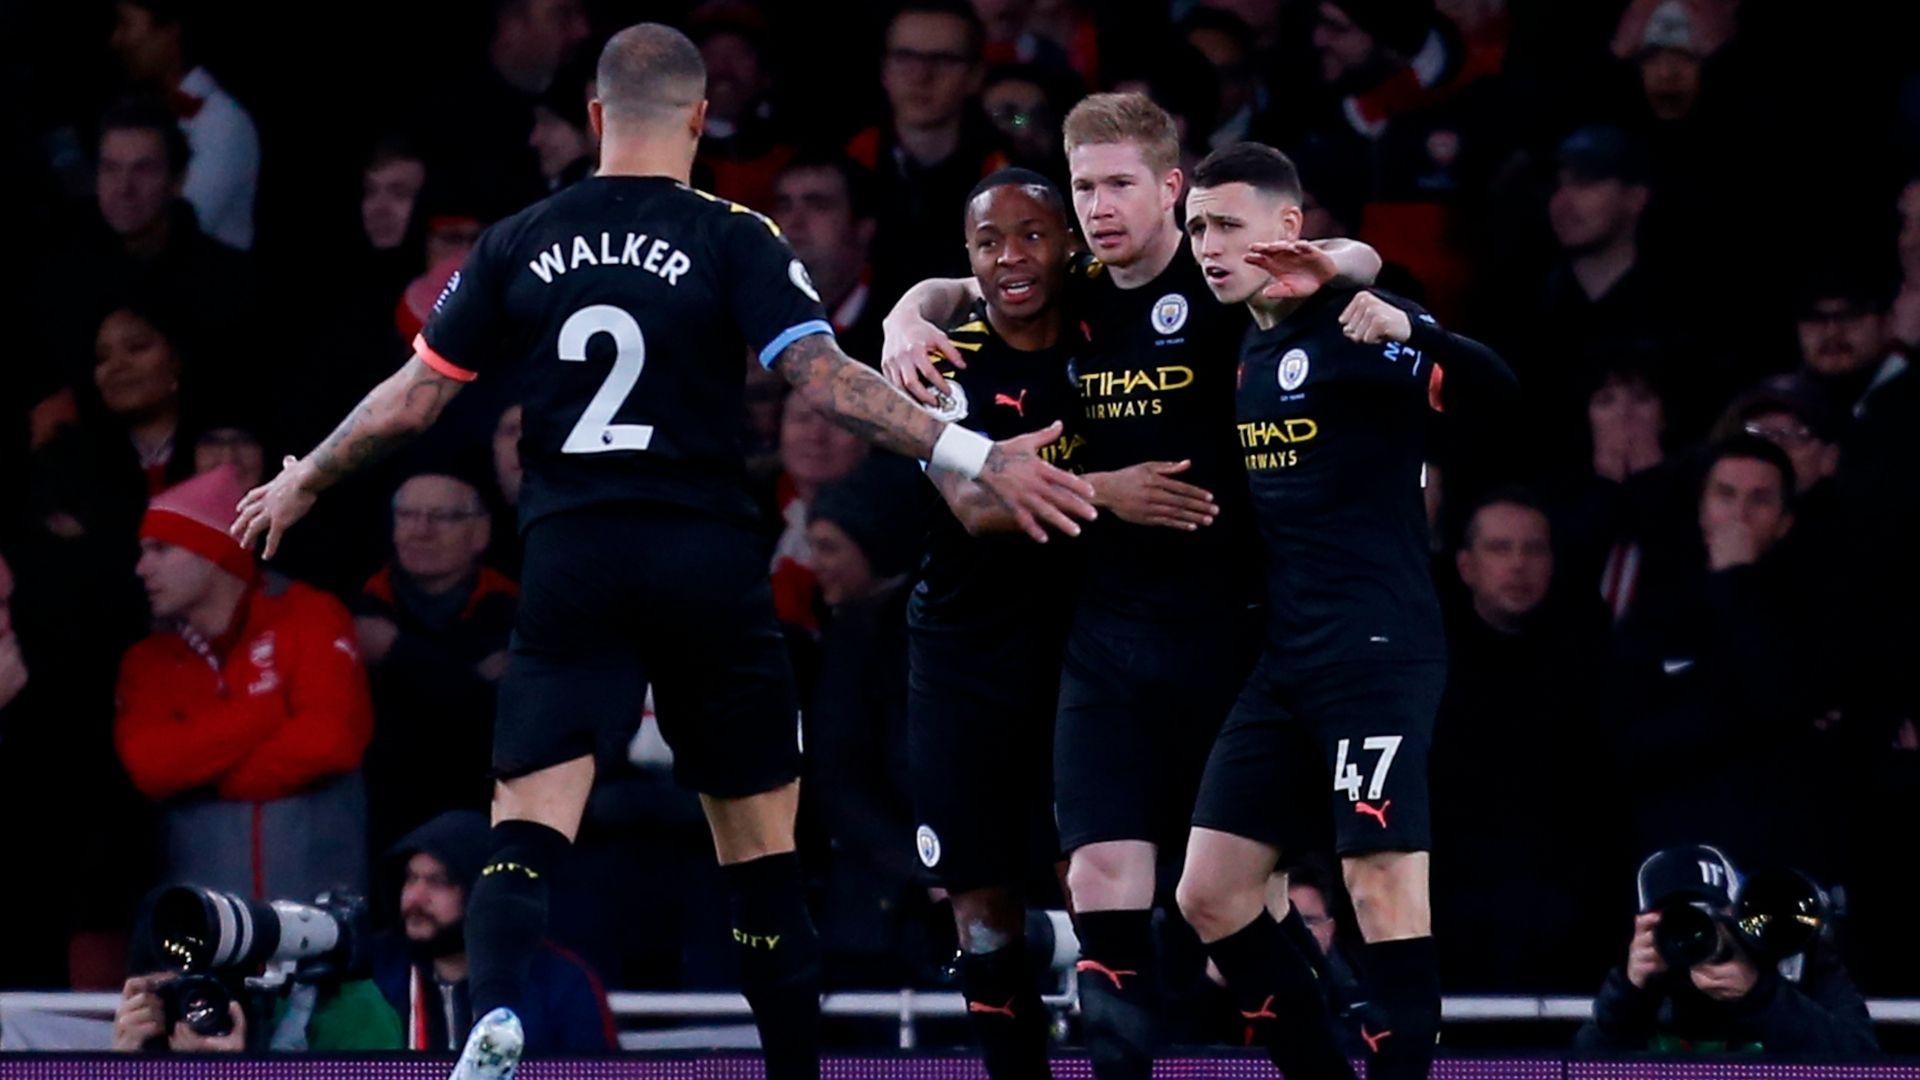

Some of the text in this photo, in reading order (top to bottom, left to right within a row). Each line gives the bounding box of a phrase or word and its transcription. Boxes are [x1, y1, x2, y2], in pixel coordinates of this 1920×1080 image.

[529, 231, 692, 286] WALKER
[557, 304, 655, 453] 2
[1237, 418, 1318, 447] TIHAD
[1245, 450, 1297, 471] IRWAYS
[1334, 735, 1403, 801] 47
[732, 927, 781, 950] CITY
